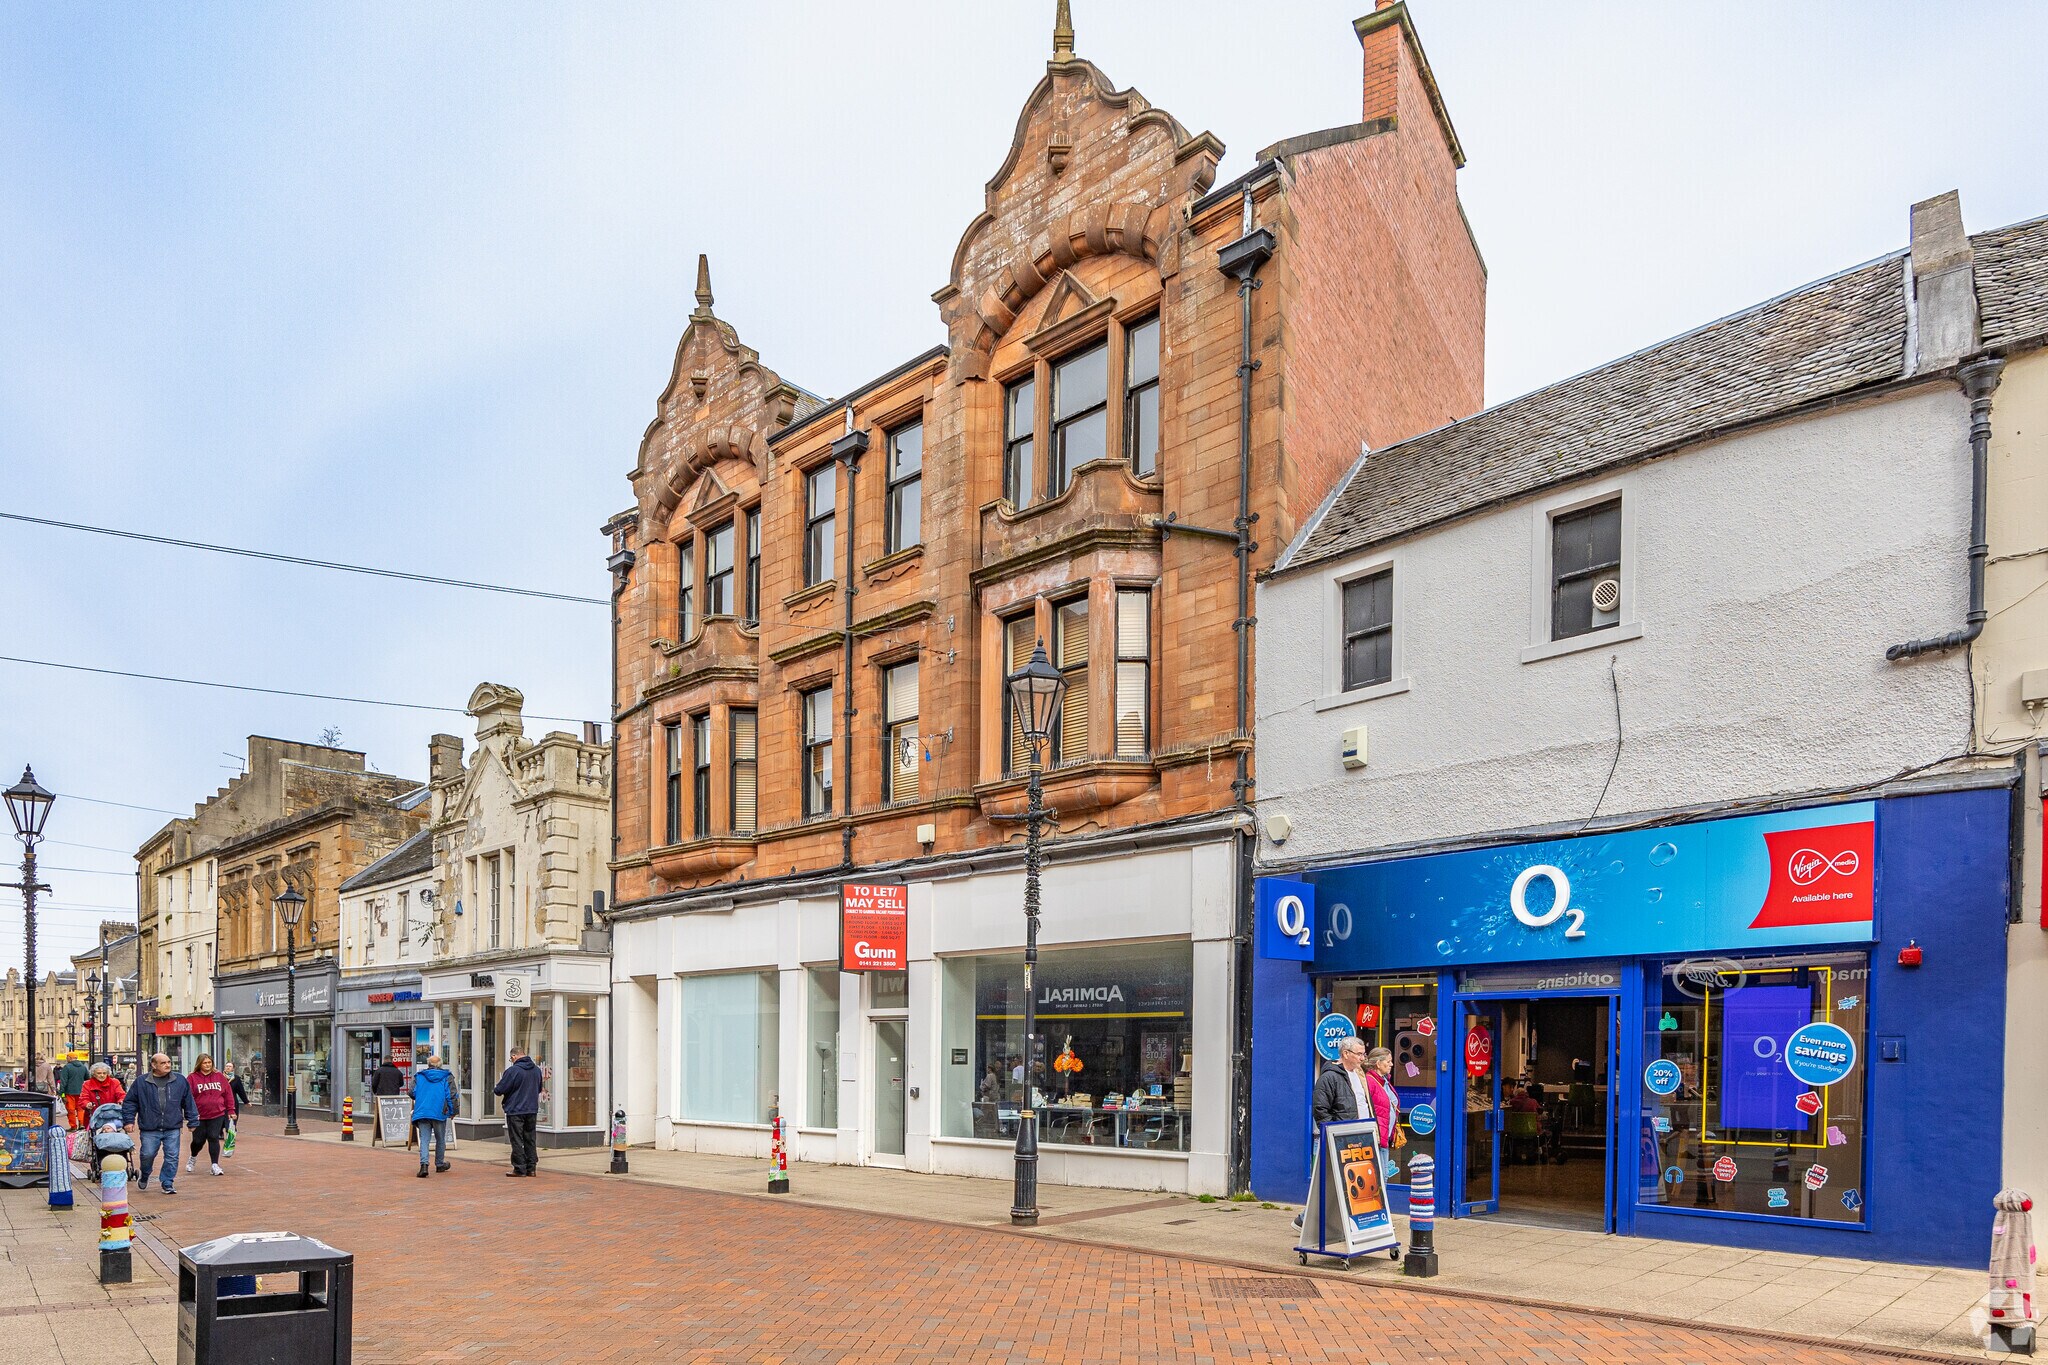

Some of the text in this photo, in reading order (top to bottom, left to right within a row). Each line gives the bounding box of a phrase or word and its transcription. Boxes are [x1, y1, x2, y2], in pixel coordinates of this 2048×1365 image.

[1793, 855, 1823, 878] Virgin
[854, 886, 898, 898] TO LET/
[1792, 892, 1854, 903] Available here
[845, 898, 906, 909] MAY SELL
[1510, 864, 1587, 938] O2
[1277, 895, 1311, 946] O2
[854, 941, 896, 959] Gunn
[506, 978, 522, 998] 3
[1324, 1027, 1346, 1037] 20%
[1327, 1038, 1342, 1048] off
[1754, 1036, 1783, 1062] O2
[1800, 1035, 1846, 1050] Even more
[1794, 1046, 1846, 1063] savings
[1653, 1069, 1673, 1077] 20%
[1818, 1063, 1842, 1074] studying
[197, 1082, 222, 1094] PARIS
[384, 1107, 406, 1120] £21
[1340, 1146, 1374, 1163] PRO
